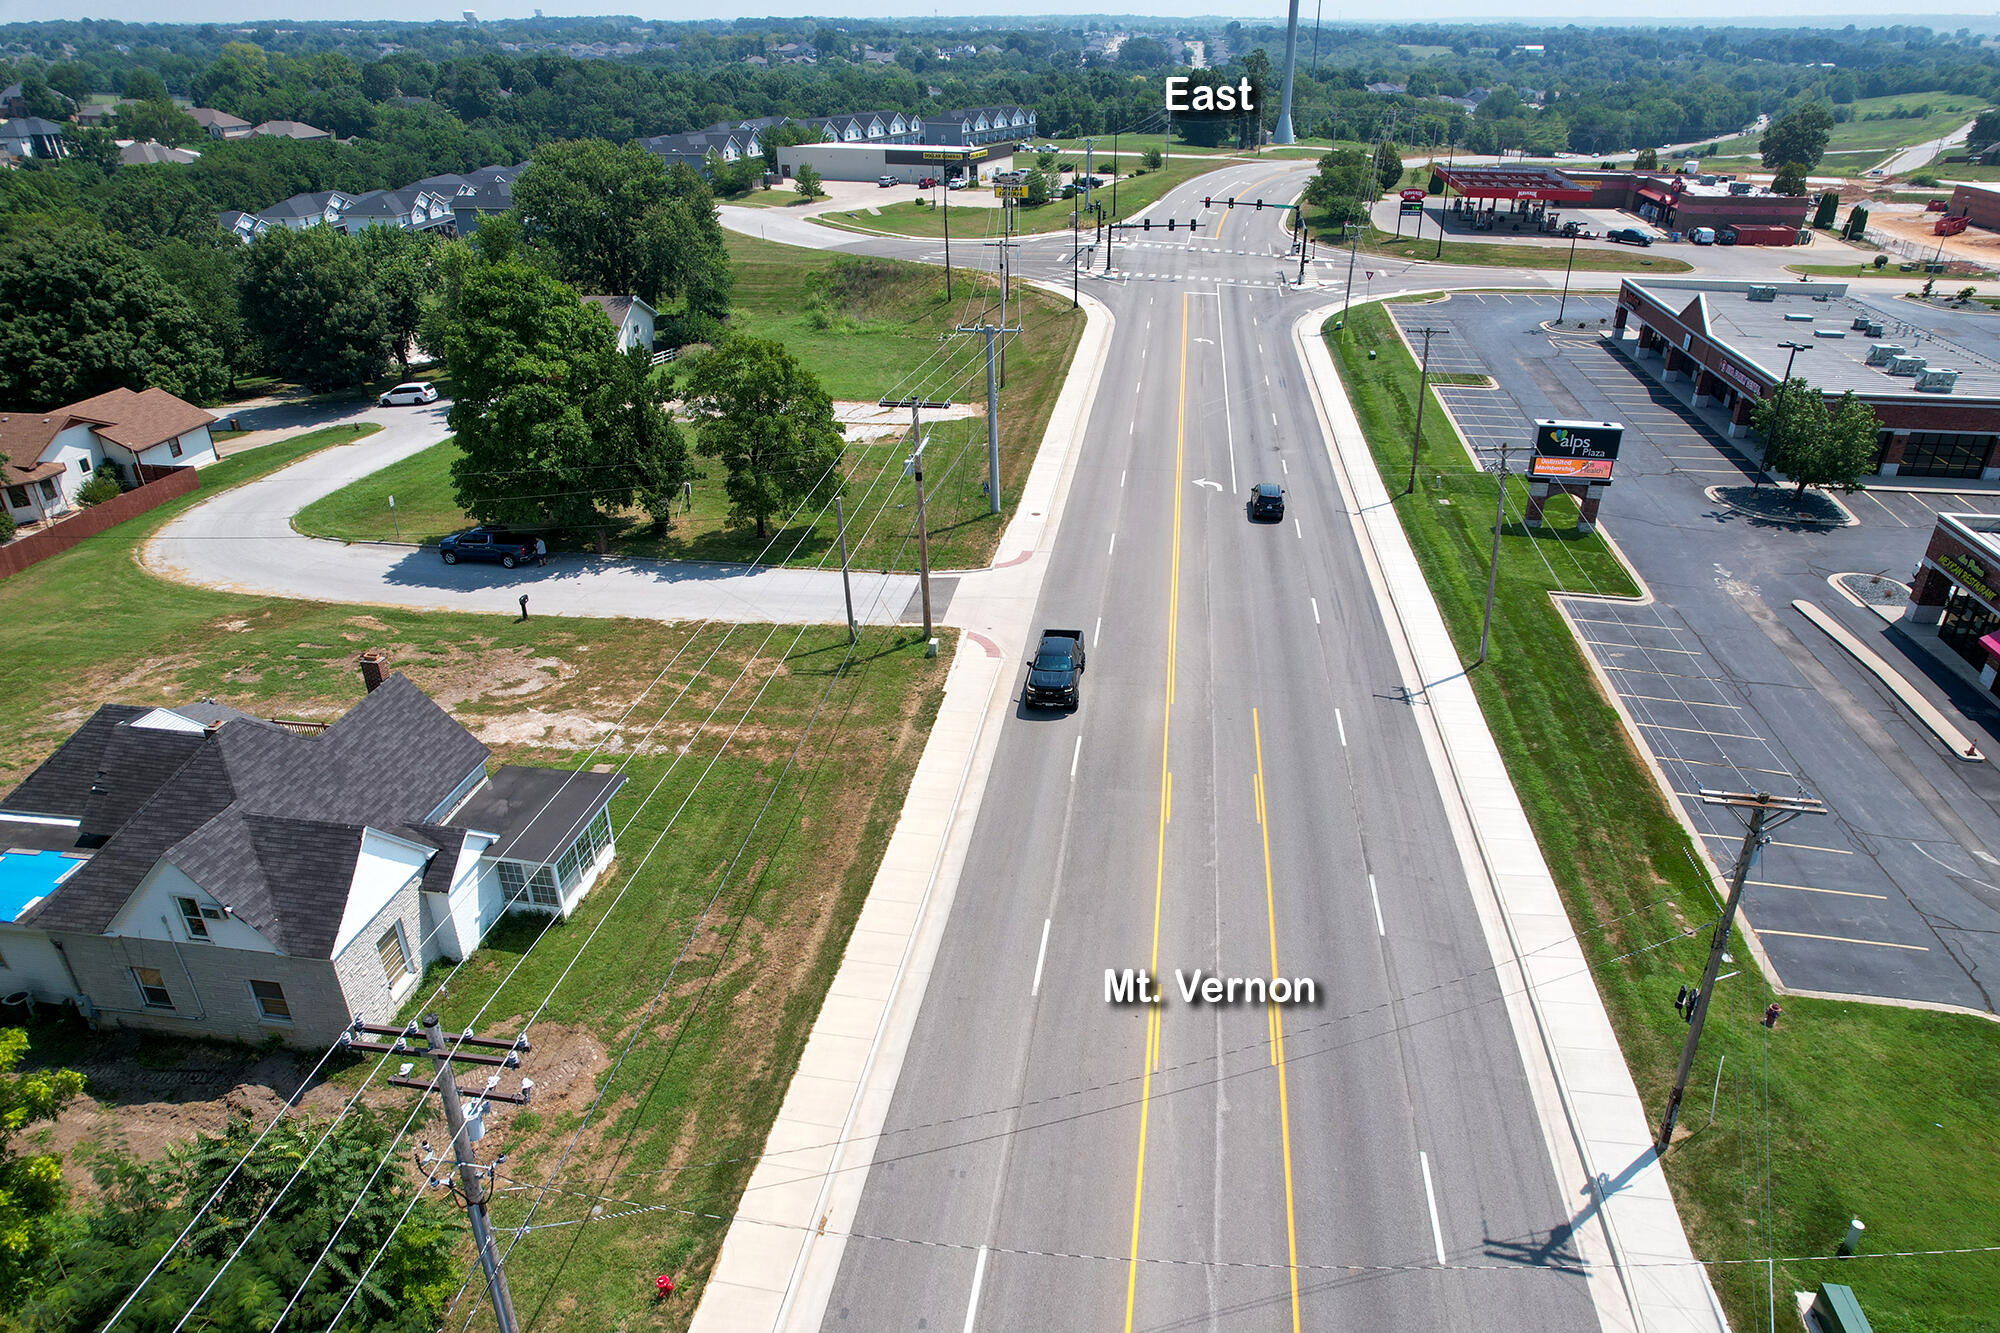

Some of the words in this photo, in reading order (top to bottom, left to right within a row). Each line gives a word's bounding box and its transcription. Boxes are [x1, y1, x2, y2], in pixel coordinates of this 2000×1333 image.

[1560, 434, 1591, 455] alps
[1582, 448, 1605, 457] Plaza
[1937, 554, 1963, 577] MEXICAN
[1960, 571, 1997, 600] RESTAURANT
